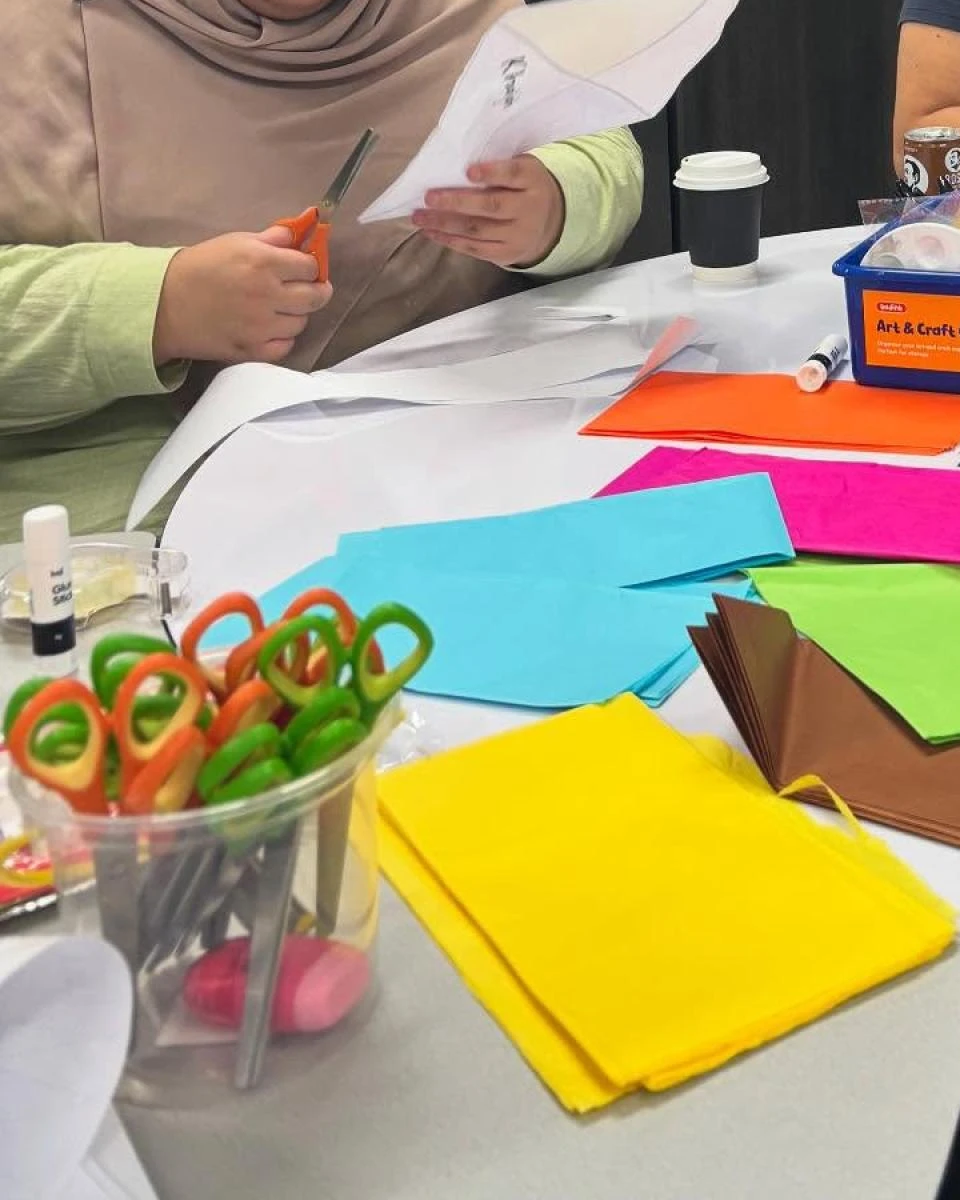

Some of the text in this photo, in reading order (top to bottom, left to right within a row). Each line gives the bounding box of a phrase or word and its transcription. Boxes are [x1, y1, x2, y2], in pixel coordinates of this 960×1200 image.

[876, 319, 900, 334] Art
[903, 321, 914, 335] &
[916, 323, 956, 338] Craft
